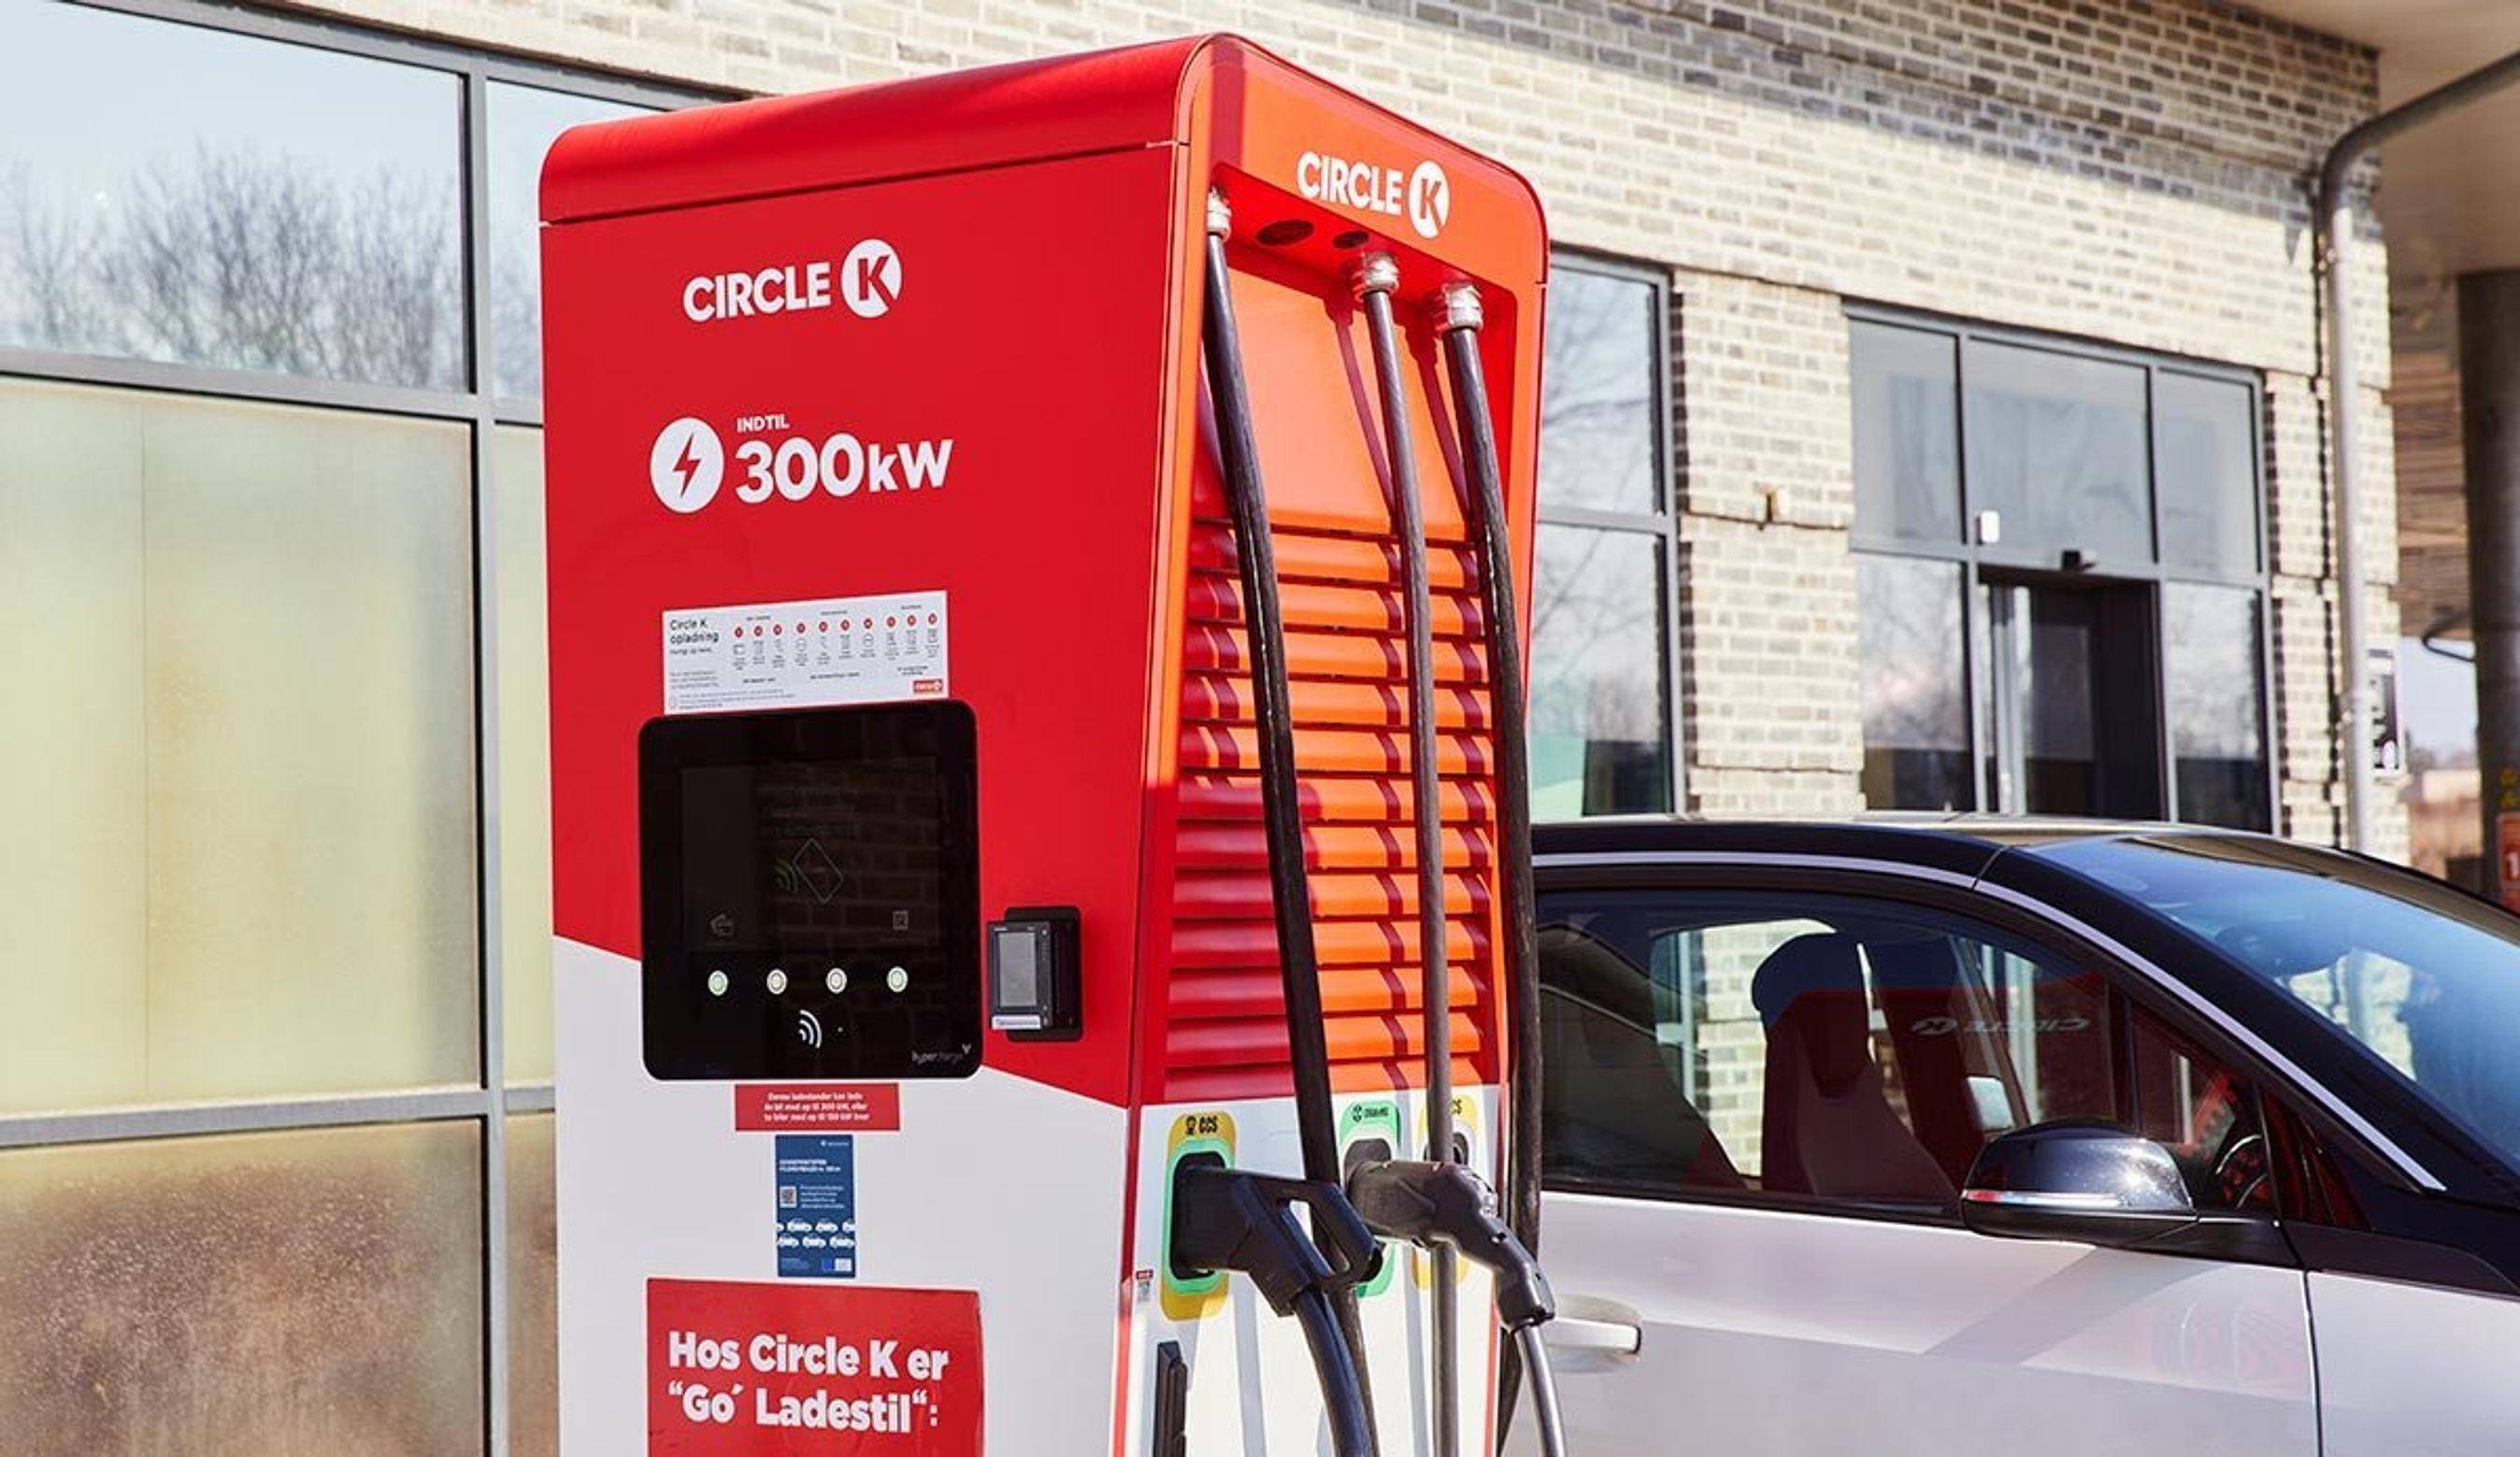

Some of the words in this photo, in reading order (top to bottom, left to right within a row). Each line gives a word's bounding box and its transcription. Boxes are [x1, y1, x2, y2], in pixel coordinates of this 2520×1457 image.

[1296, 150, 1404, 216] CIRCLE
[683, 262, 831, 321] CIRCLE
[736, 414, 790, 433] INDTIL
[668, 1331, 741, 1371] Hos
[749, 1334, 860, 1377] Circle
[868, 1339, 900, 1378] K
[907, 1349, 950, 1381] er
